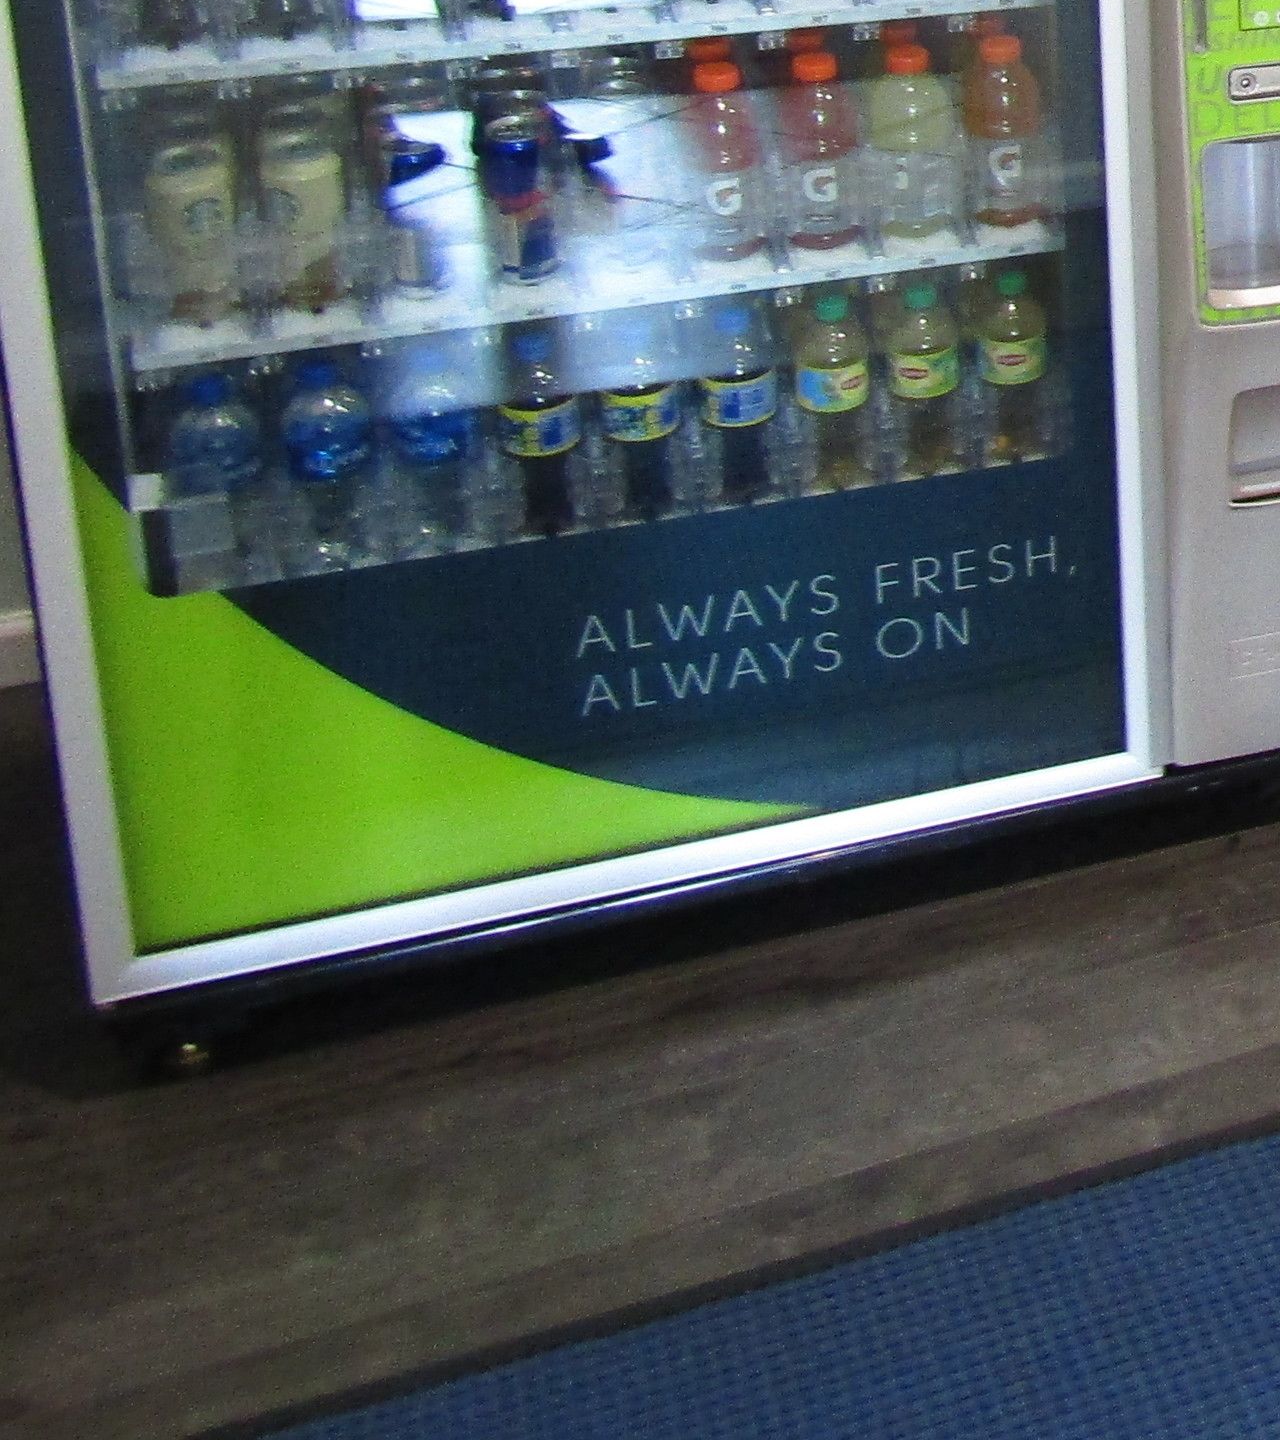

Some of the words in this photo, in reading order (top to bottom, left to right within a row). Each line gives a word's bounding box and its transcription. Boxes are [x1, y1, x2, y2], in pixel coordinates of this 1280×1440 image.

[575, 573, 841, 659] ALWAYS
[874, 534, 1078, 605] FRESH,
[581, 630, 844, 717] ALWAYS
[876, 606, 972, 659] ON
